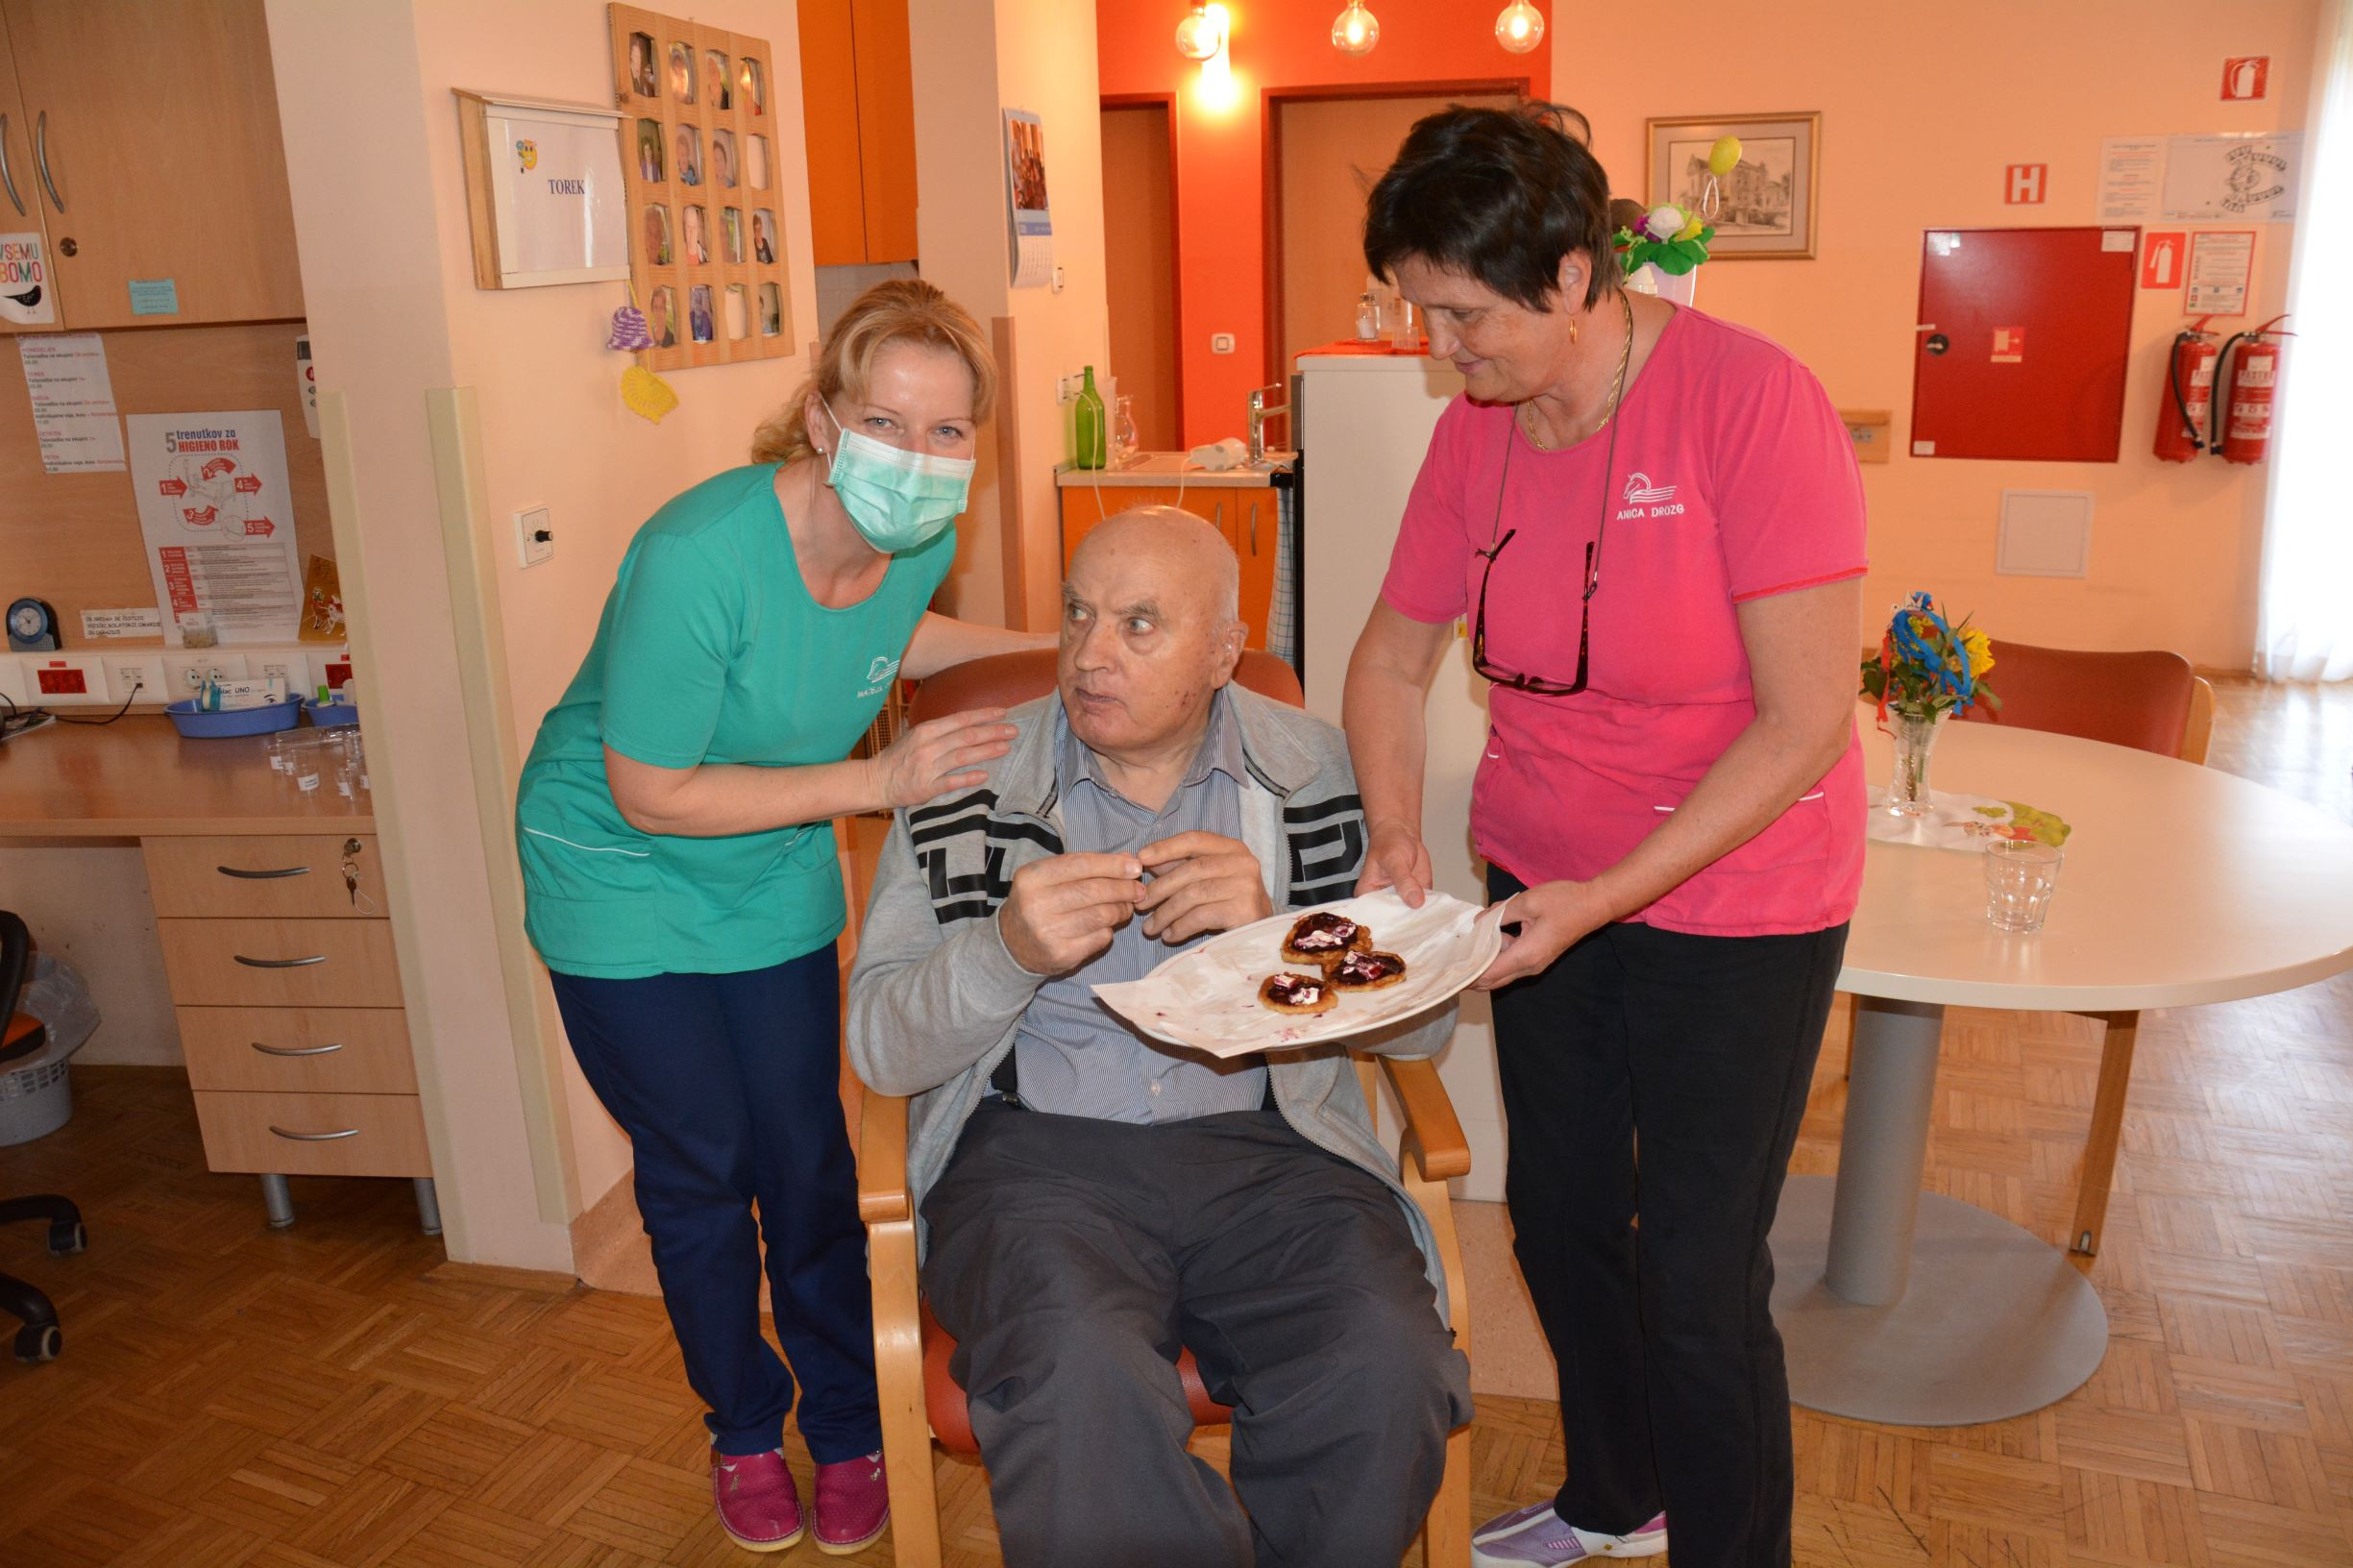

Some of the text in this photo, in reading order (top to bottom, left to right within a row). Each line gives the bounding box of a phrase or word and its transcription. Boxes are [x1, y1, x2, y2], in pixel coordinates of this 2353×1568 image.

[547, 179, 585, 195] TOREK
[2012, 166, 2040, 202] H
[0, 260, 42, 283] BOMO
[165, 428, 235, 453] 5 trenutkov za
[178, 439, 239, 453] HIGIENO ROK
[203, 468, 212, 478] 2
[160, 483, 168, 492] 1
[236, 480, 244, 491] 4
[186, 509, 194, 519] 3
[1616, 503, 1684, 521] ANICA DROZG
[247, 523, 255, 533] 5
[168, 581, 175, 590] 3
